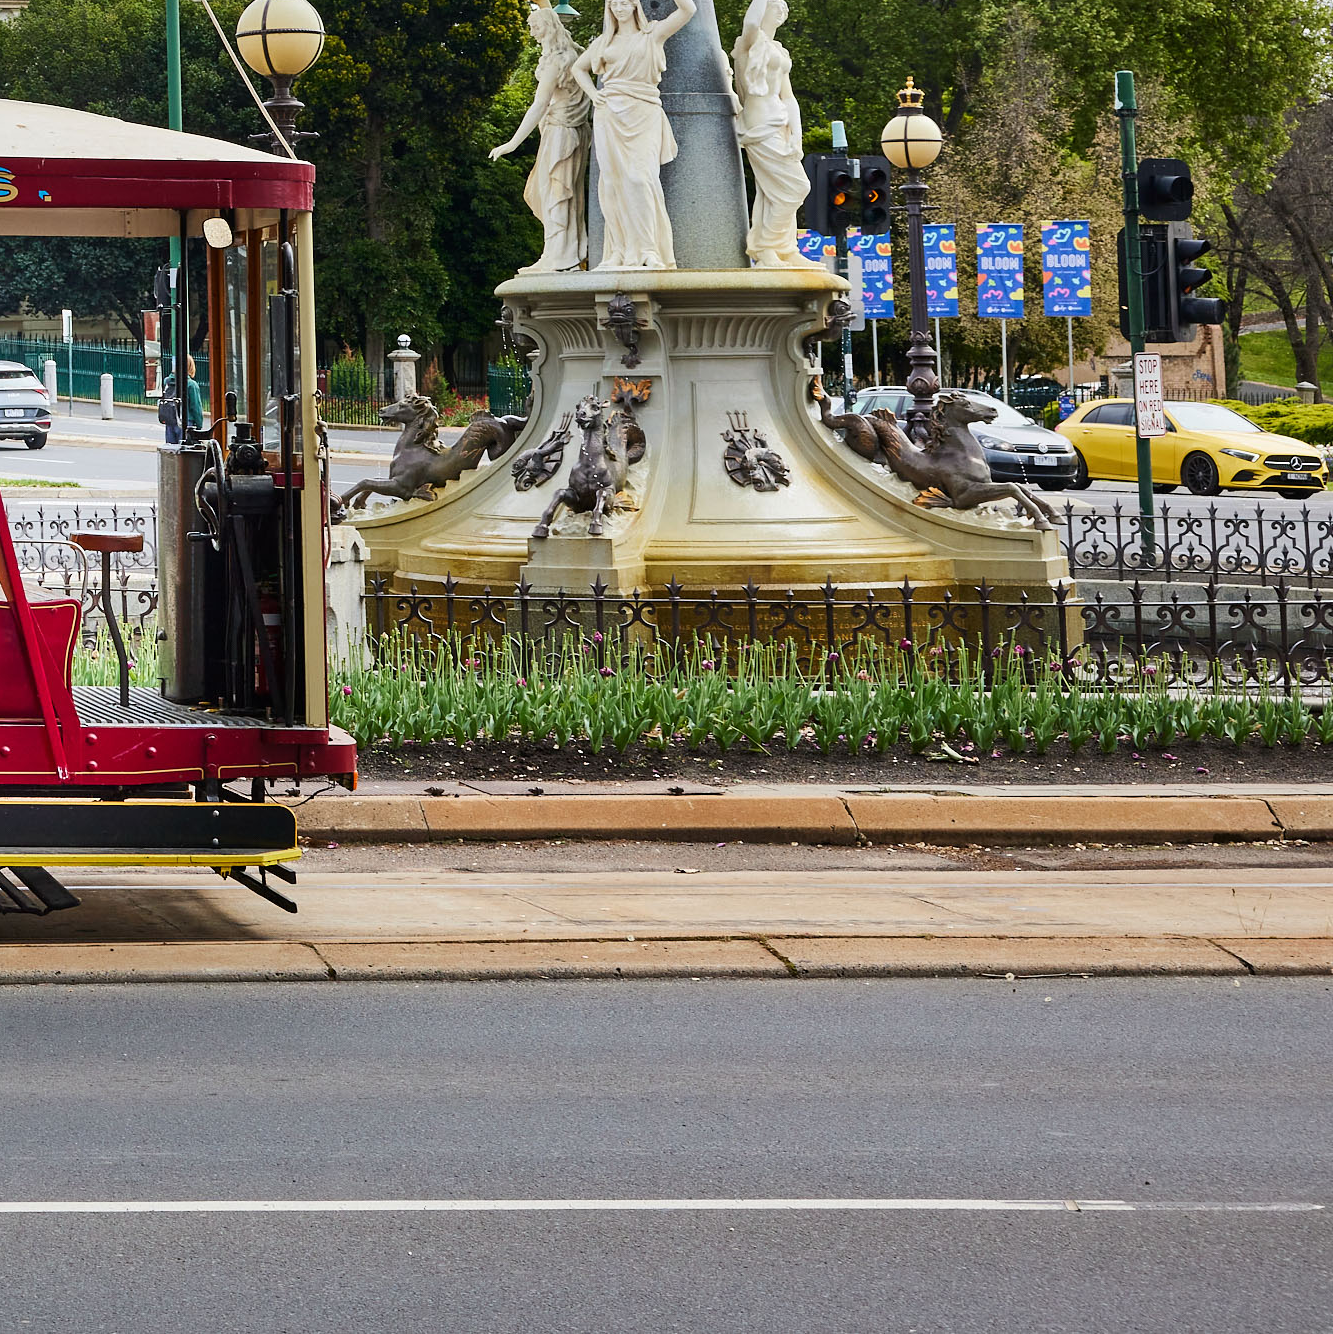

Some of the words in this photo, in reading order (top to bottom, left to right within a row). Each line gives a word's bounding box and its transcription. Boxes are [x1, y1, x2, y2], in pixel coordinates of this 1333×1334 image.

[862, 259, 888, 273] OOM
[925, 257, 953, 270] OOM
[980, 257, 1019, 270] BLOOM
[1046, 254, 1086, 268] BLOOM
[1139, 359, 1158, 374] STOP
[1139, 379, 1159, 394] HERE
[1139, 400, 1148, 412] ON
[1149, 399, 1162, 412] RED
[1141, 417, 1164, 431] SIGNAL
